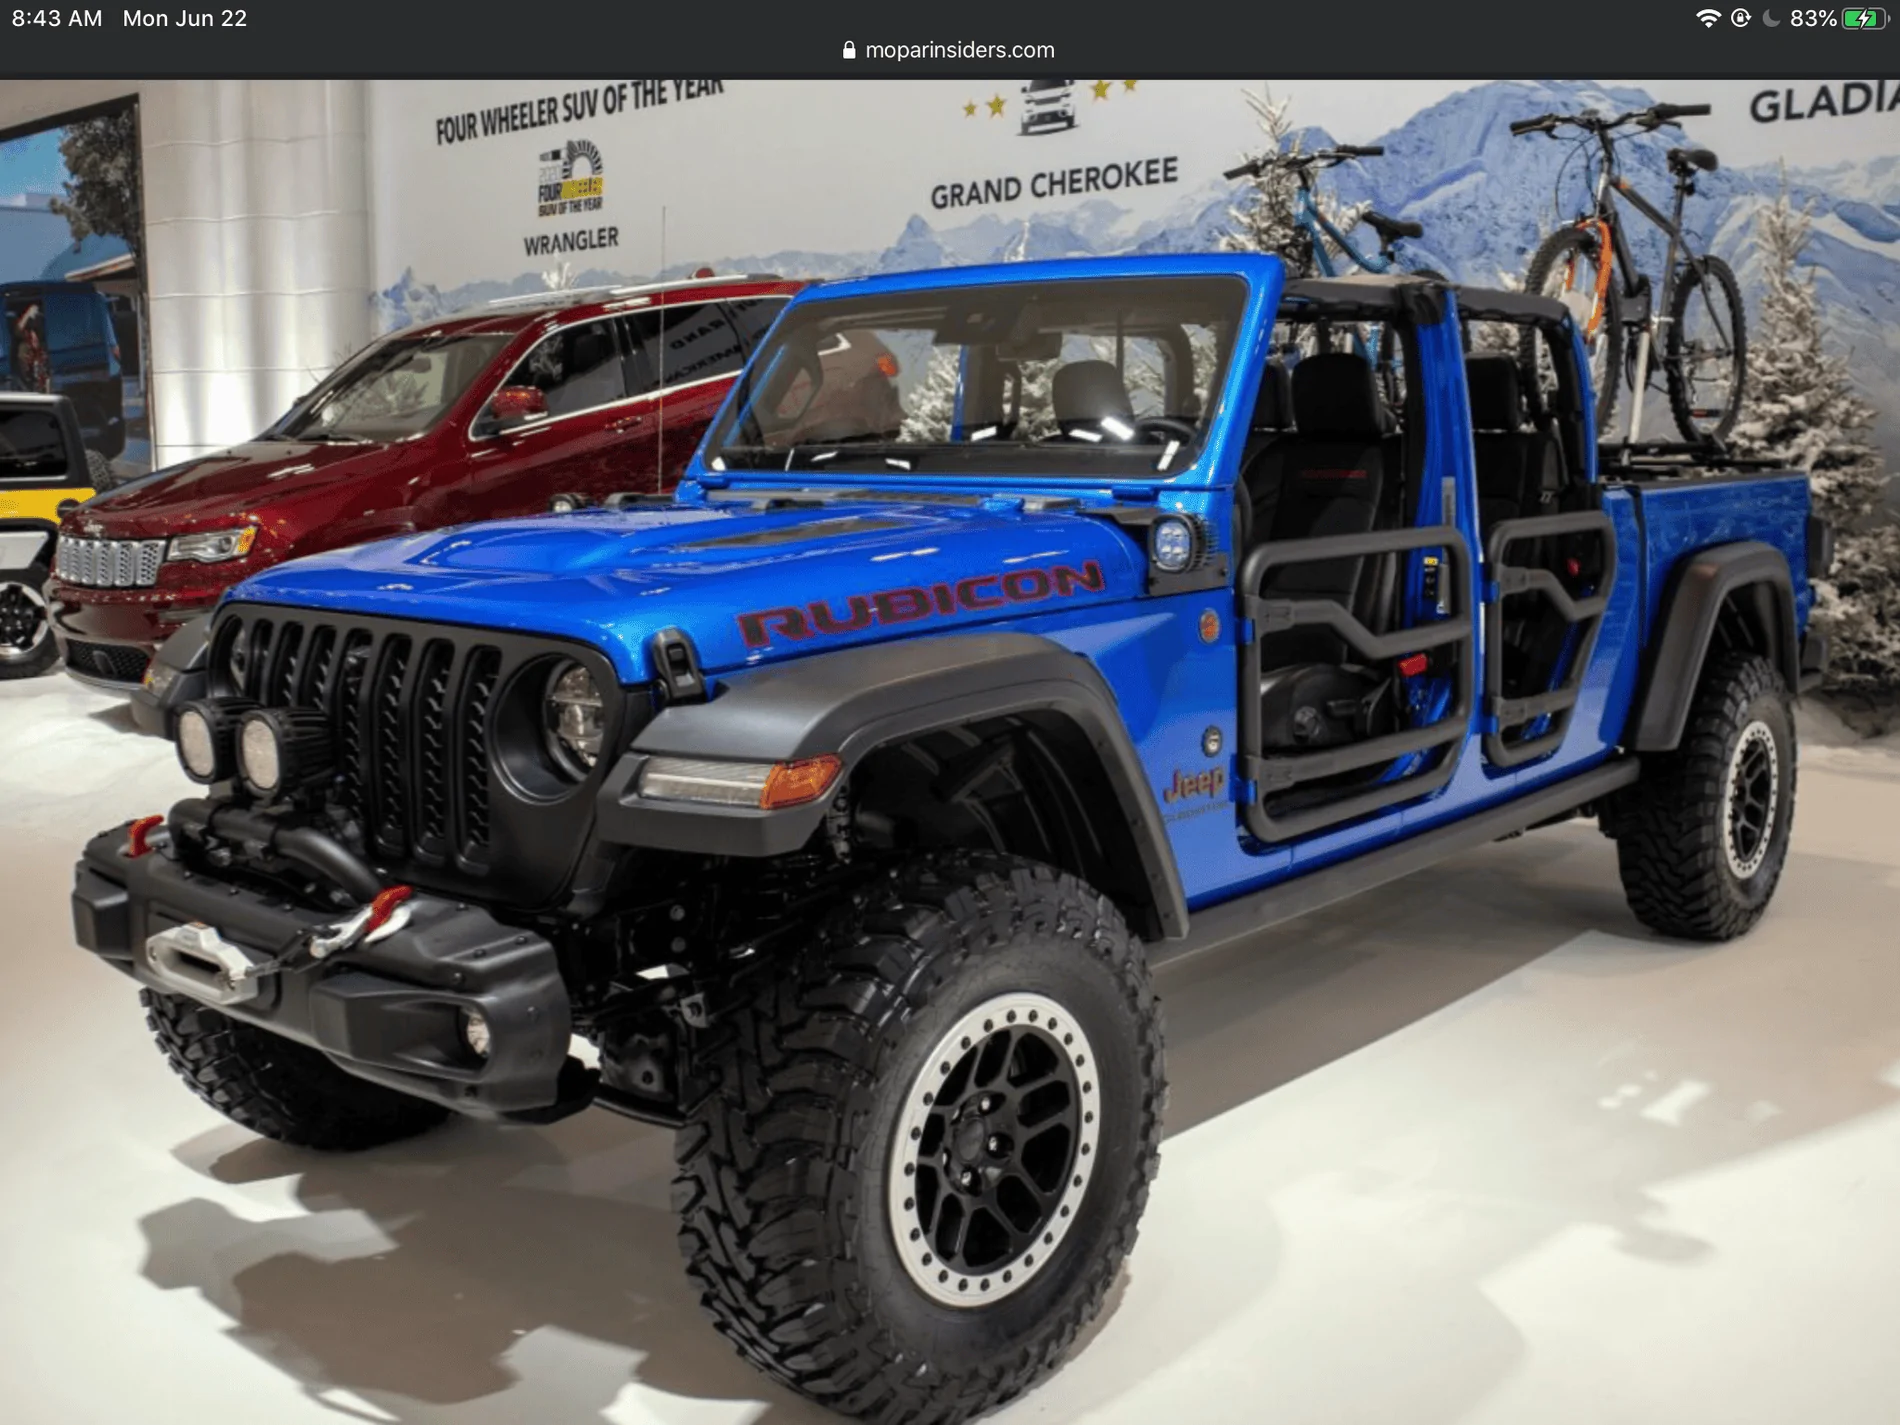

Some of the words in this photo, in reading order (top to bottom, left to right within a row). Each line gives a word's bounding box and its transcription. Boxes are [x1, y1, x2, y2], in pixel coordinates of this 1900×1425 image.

[436, 112, 478, 146] FOUR
[480, 96, 559, 137] WHEELER
[562, 88, 599, 123] SUV
[603, 83, 628, 115] OF
[631, 80, 668, 110] THE
[931, 176, 1023, 210] GRAND
[1030, 156, 1179, 199] CHEROKEE
[523, 226, 619, 257] WRANGLER
[738, 561, 1104, 649] RUBICON
[1163, 766, 1226, 804] Jeep
